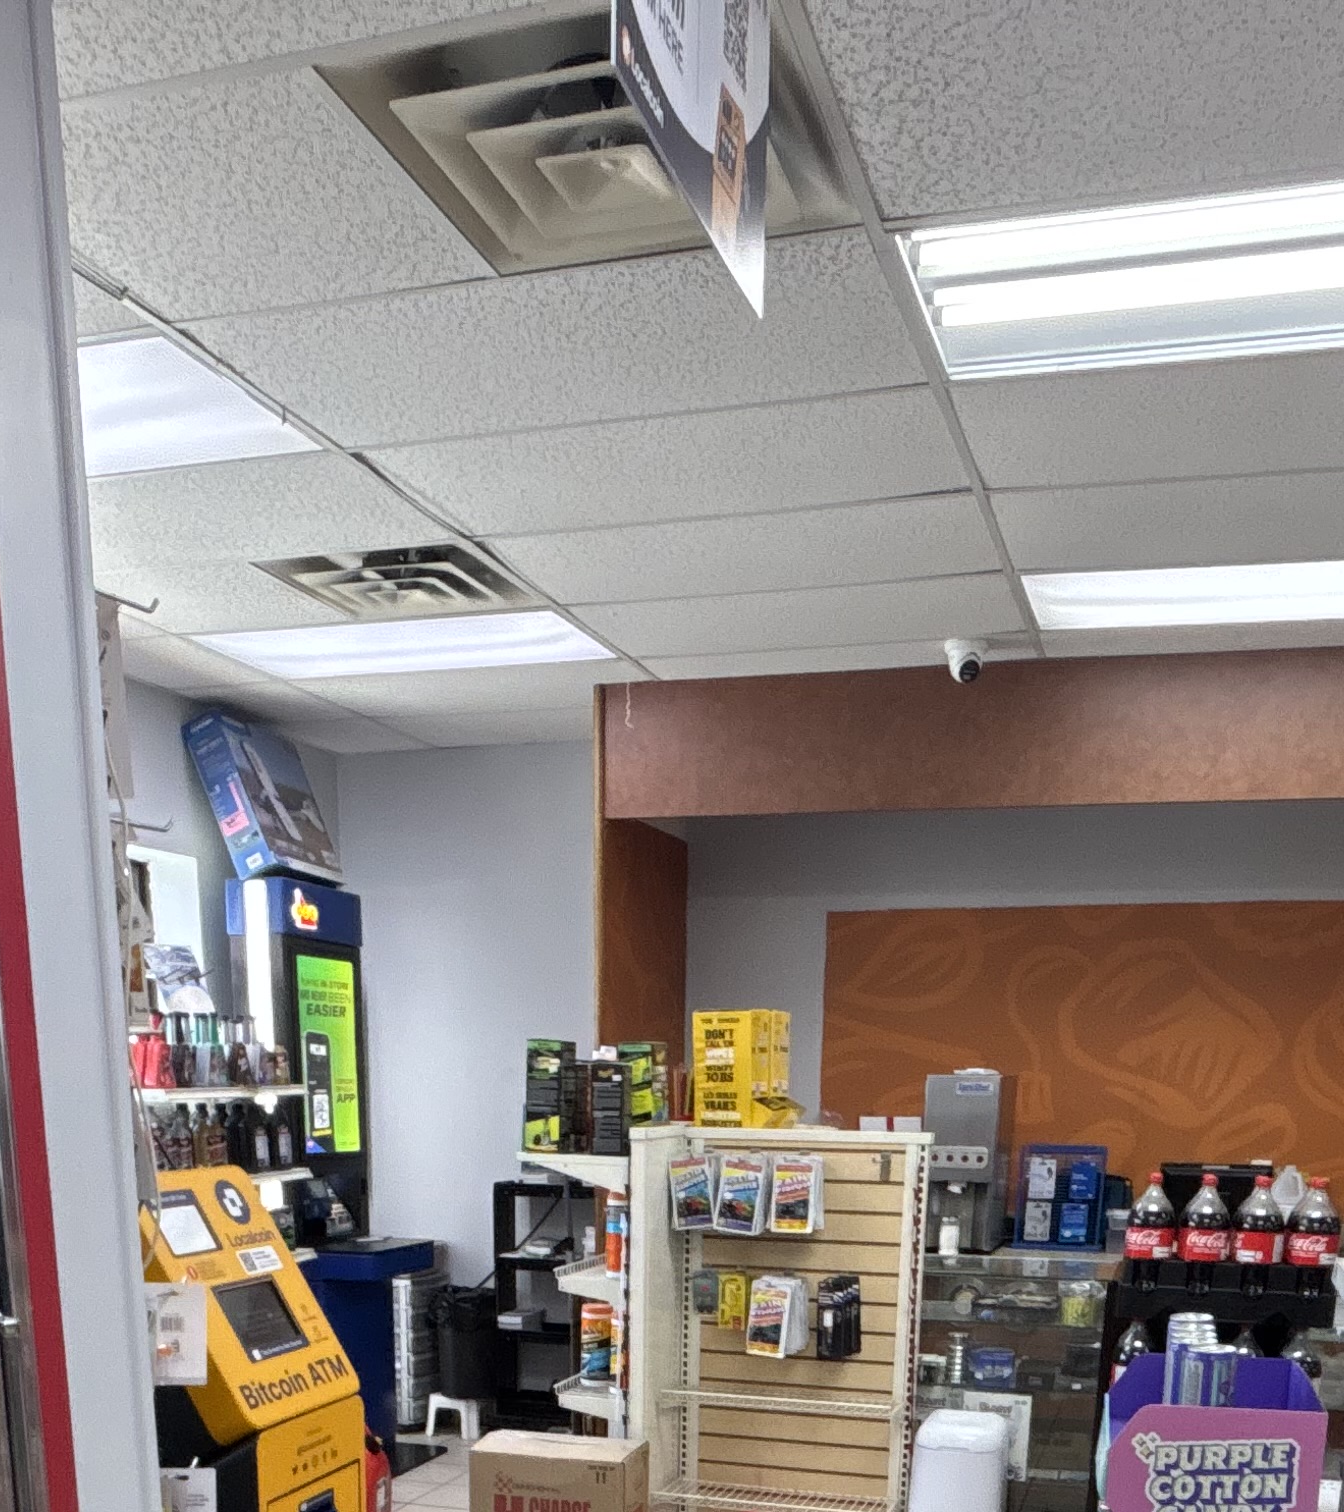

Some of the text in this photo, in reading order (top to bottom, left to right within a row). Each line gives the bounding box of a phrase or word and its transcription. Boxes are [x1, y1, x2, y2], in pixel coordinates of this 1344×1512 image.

[306, 1003, 346, 1017] EASIER
[224, 1229, 276, 1248] Localcoin
[238, 1354, 350, 1410] Bitcoin ATM
[1154, 1443, 1294, 1473] PURPLE
[1149, 1472, 1294, 1503] COTTON
